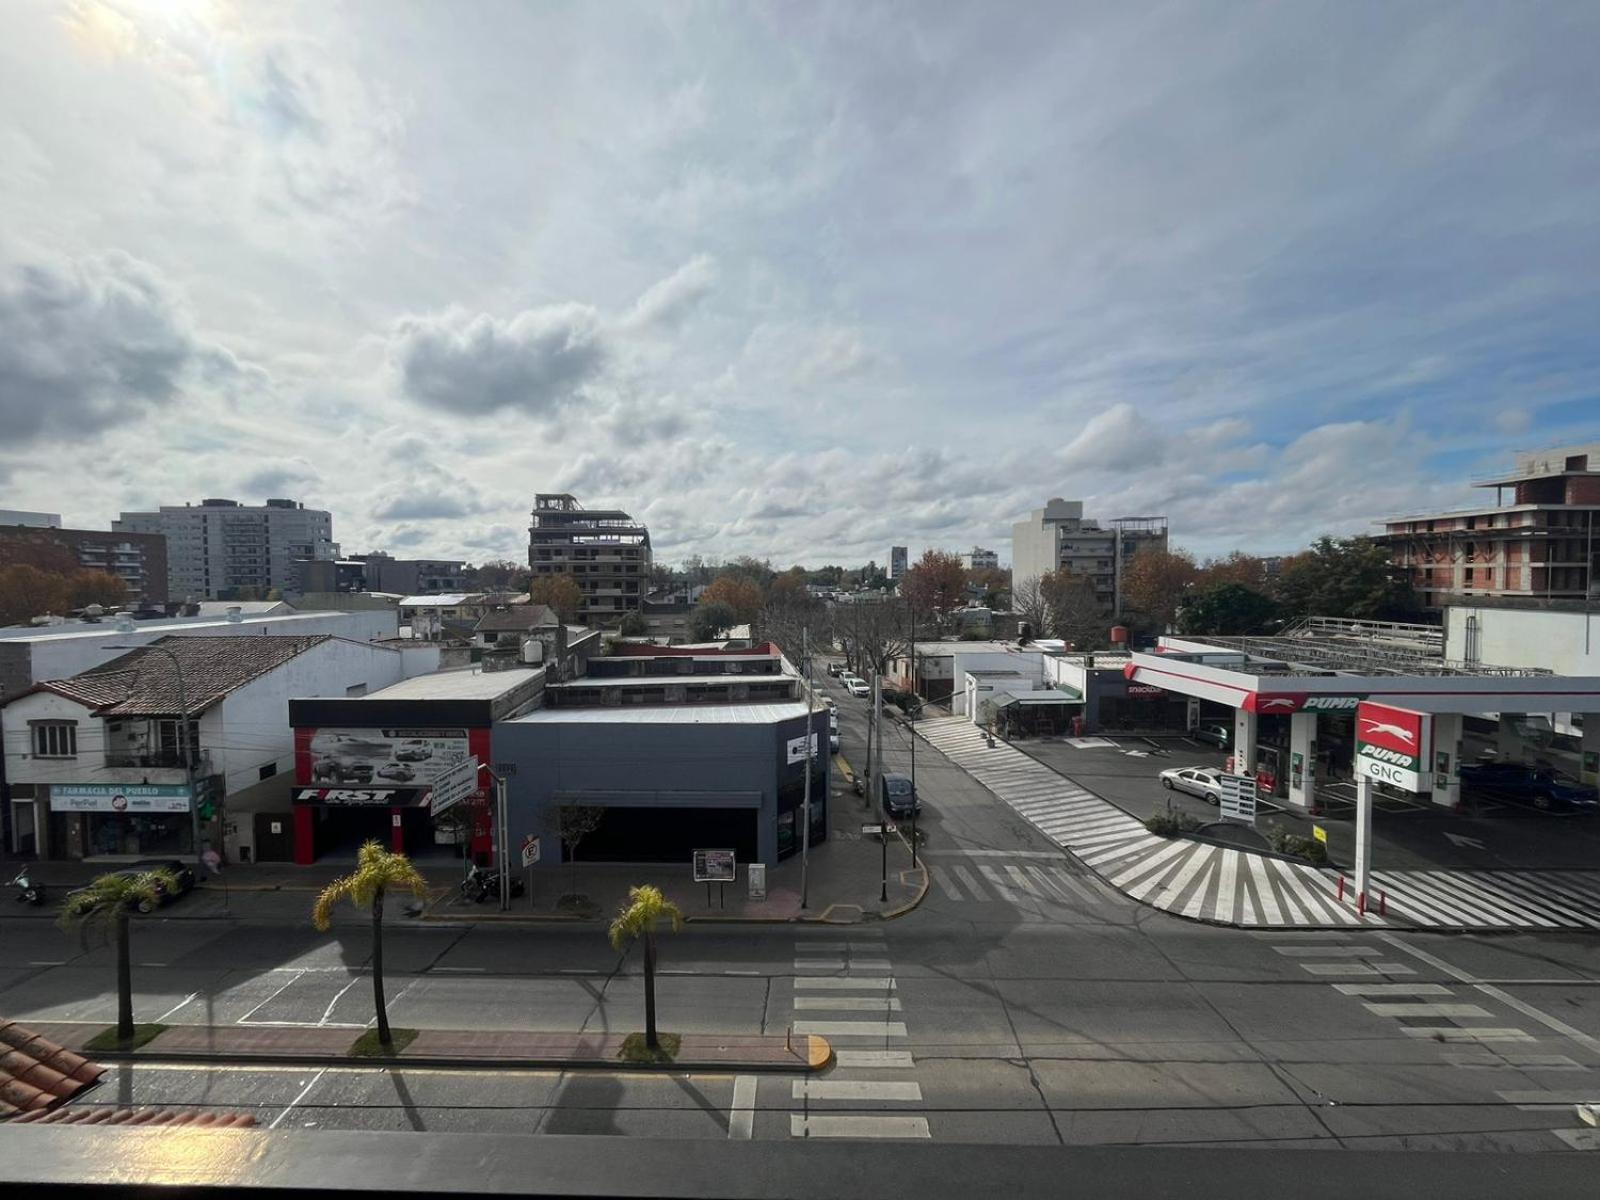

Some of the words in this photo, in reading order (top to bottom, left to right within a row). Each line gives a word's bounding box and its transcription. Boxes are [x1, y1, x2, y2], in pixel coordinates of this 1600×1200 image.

[1302, 697, 1360, 709] PUMA
[1361, 744, 1413, 767] PUMA
[1370, 763, 1403, 783] GNC
[62, 787, 106, 795] FARMACIA
[108, 787, 124, 795] DEL
[126, 787, 158, 795] PUEBLO
